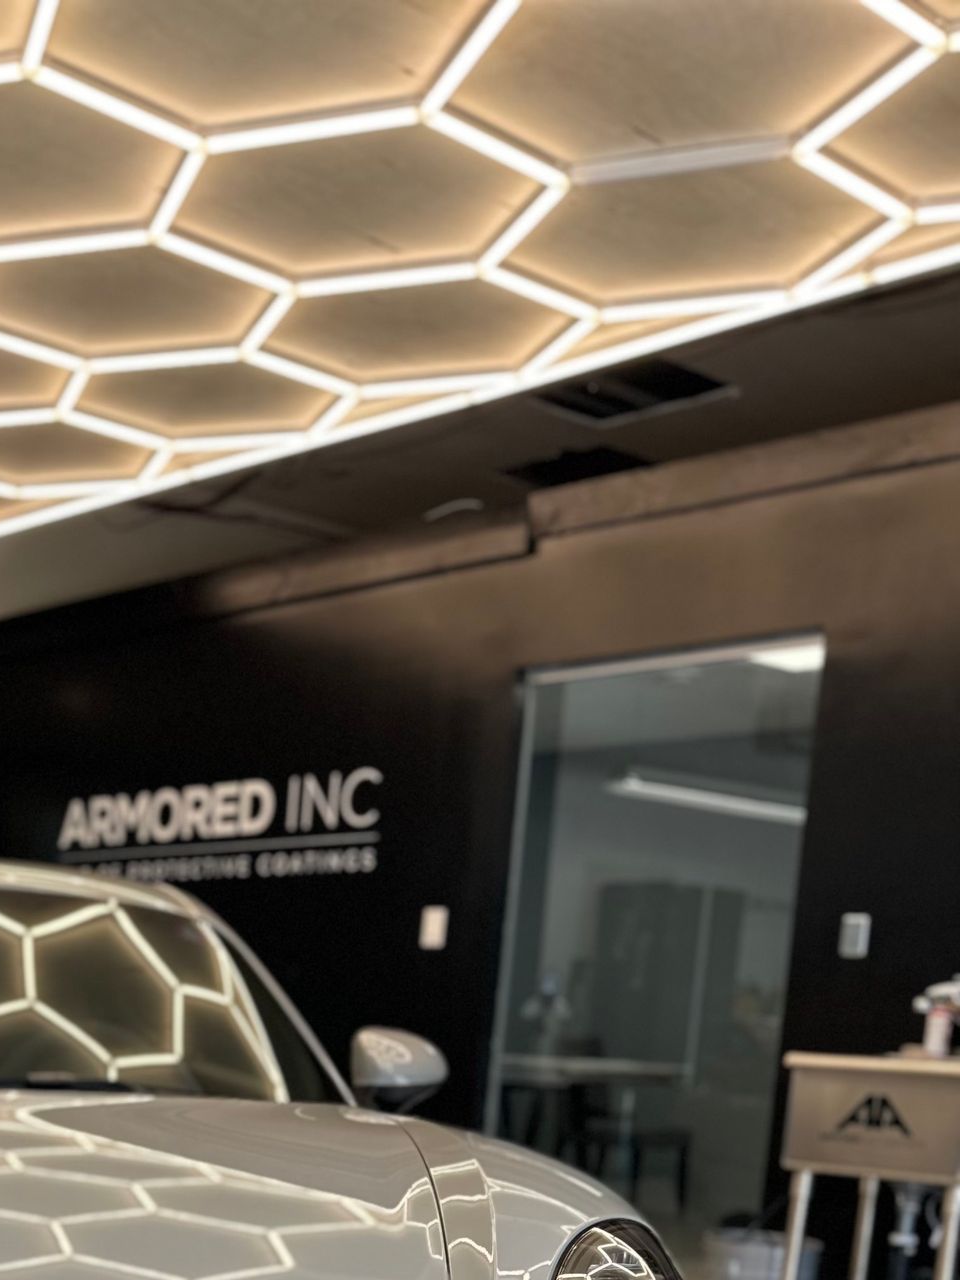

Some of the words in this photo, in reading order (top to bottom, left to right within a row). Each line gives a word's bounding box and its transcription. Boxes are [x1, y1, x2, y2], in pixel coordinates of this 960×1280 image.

[57, 777, 276, 849] ARMORED
[285, 766, 384, 833] INC
[254, 846, 377, 878] COATINGS
